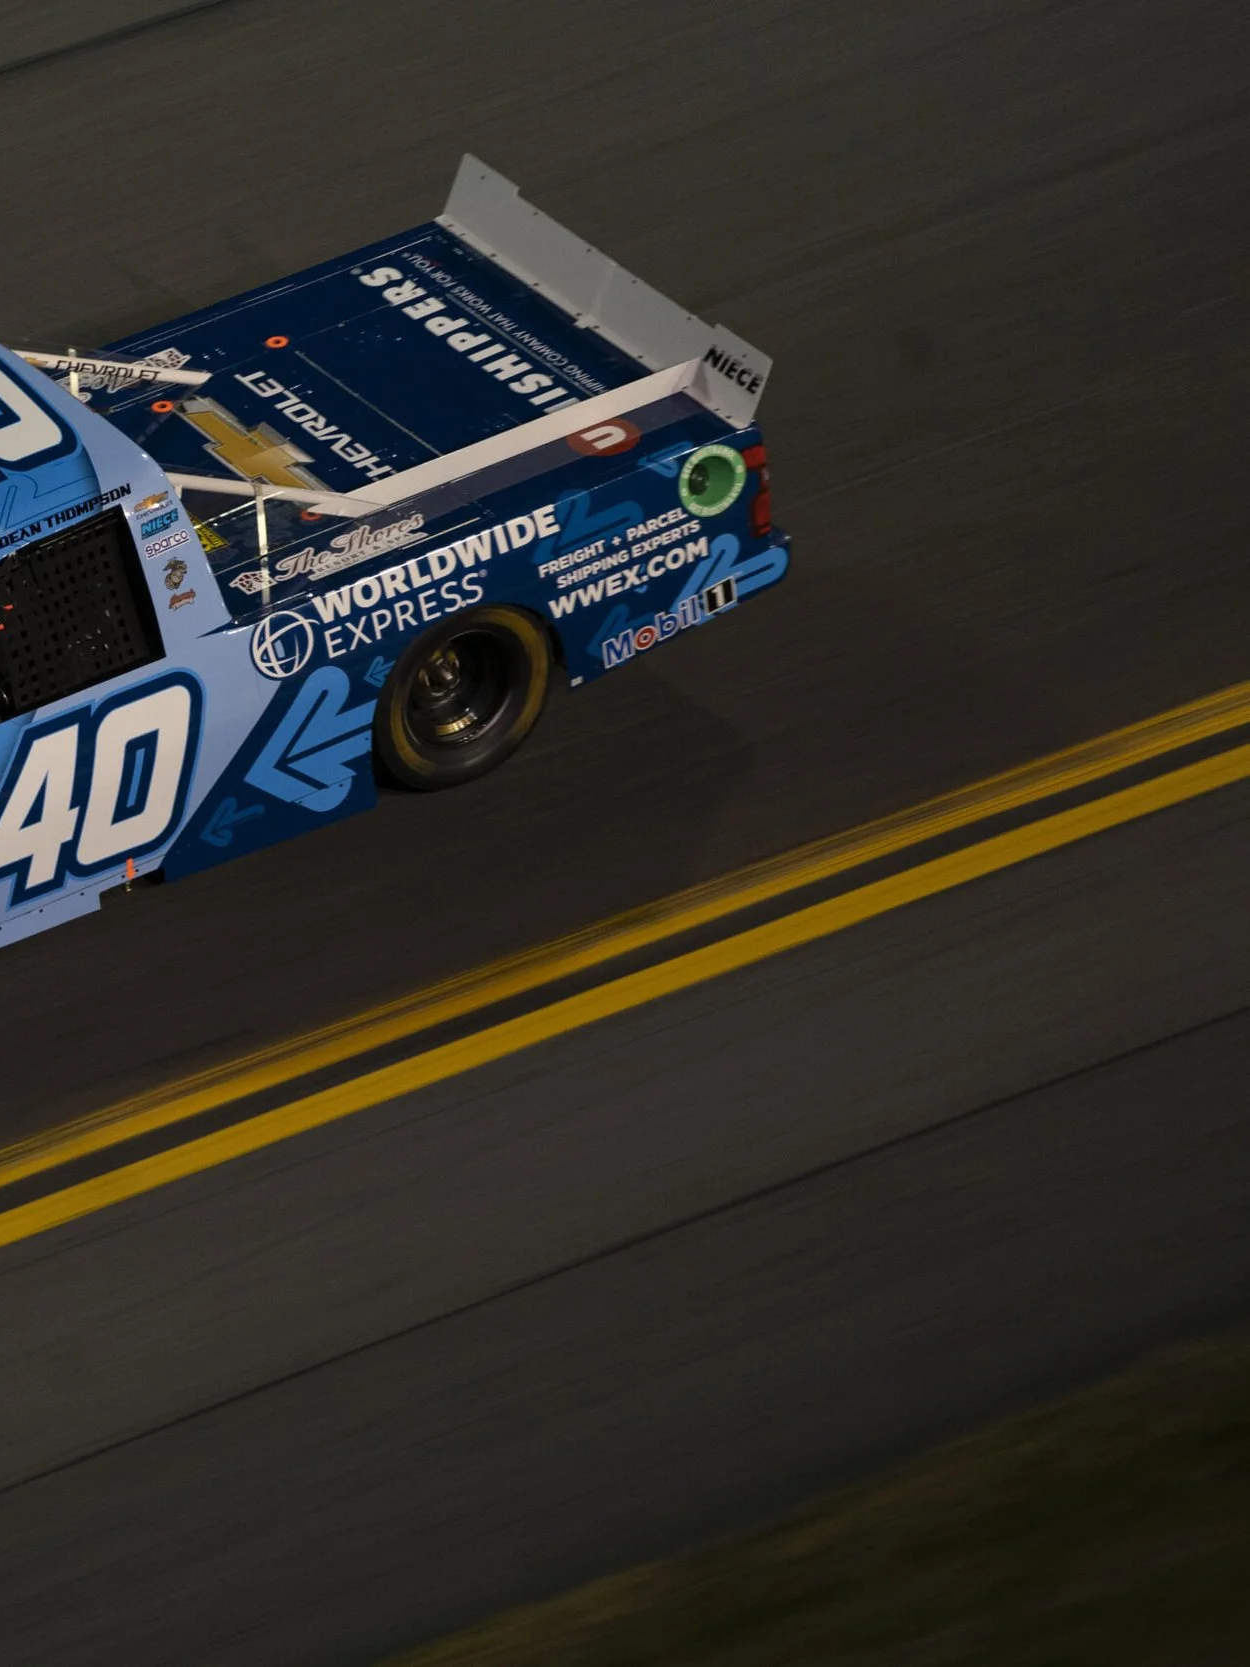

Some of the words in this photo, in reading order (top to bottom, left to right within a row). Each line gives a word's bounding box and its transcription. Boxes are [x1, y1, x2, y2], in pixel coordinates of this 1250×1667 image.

[450, 285, 492, 314] WORKS
[486, 312, 518, 332] THAT
[54, 358, 161, 383] CHEVROLET
[512, 330, 569, 366] COMPANY
[703, 344, 762, 396] NIECE
[563, 364, 608, 393] HIPPING
[44, 483, 132, 531] THOMPSON
[141, 508, 179, 534] NIECE
[145, 530, 188, 557] sparco
[275, 546, 330, 582] The
[330, 513, 425, 556] Shores
[312, 504, 561, 625] WORLDWIDE
[538, 538, 605, 578] FREIGHT
[625, 507, 688, 543] PARCEL
[556, 548, 629, 589] SHIPPING
[631, 519, 701, 558] EXPERTS
[548, 536, 709, 620] WWEX.COM
[323, 574, 484, 659] EXPRESS
[601, 593, 699, 670] Mobil
